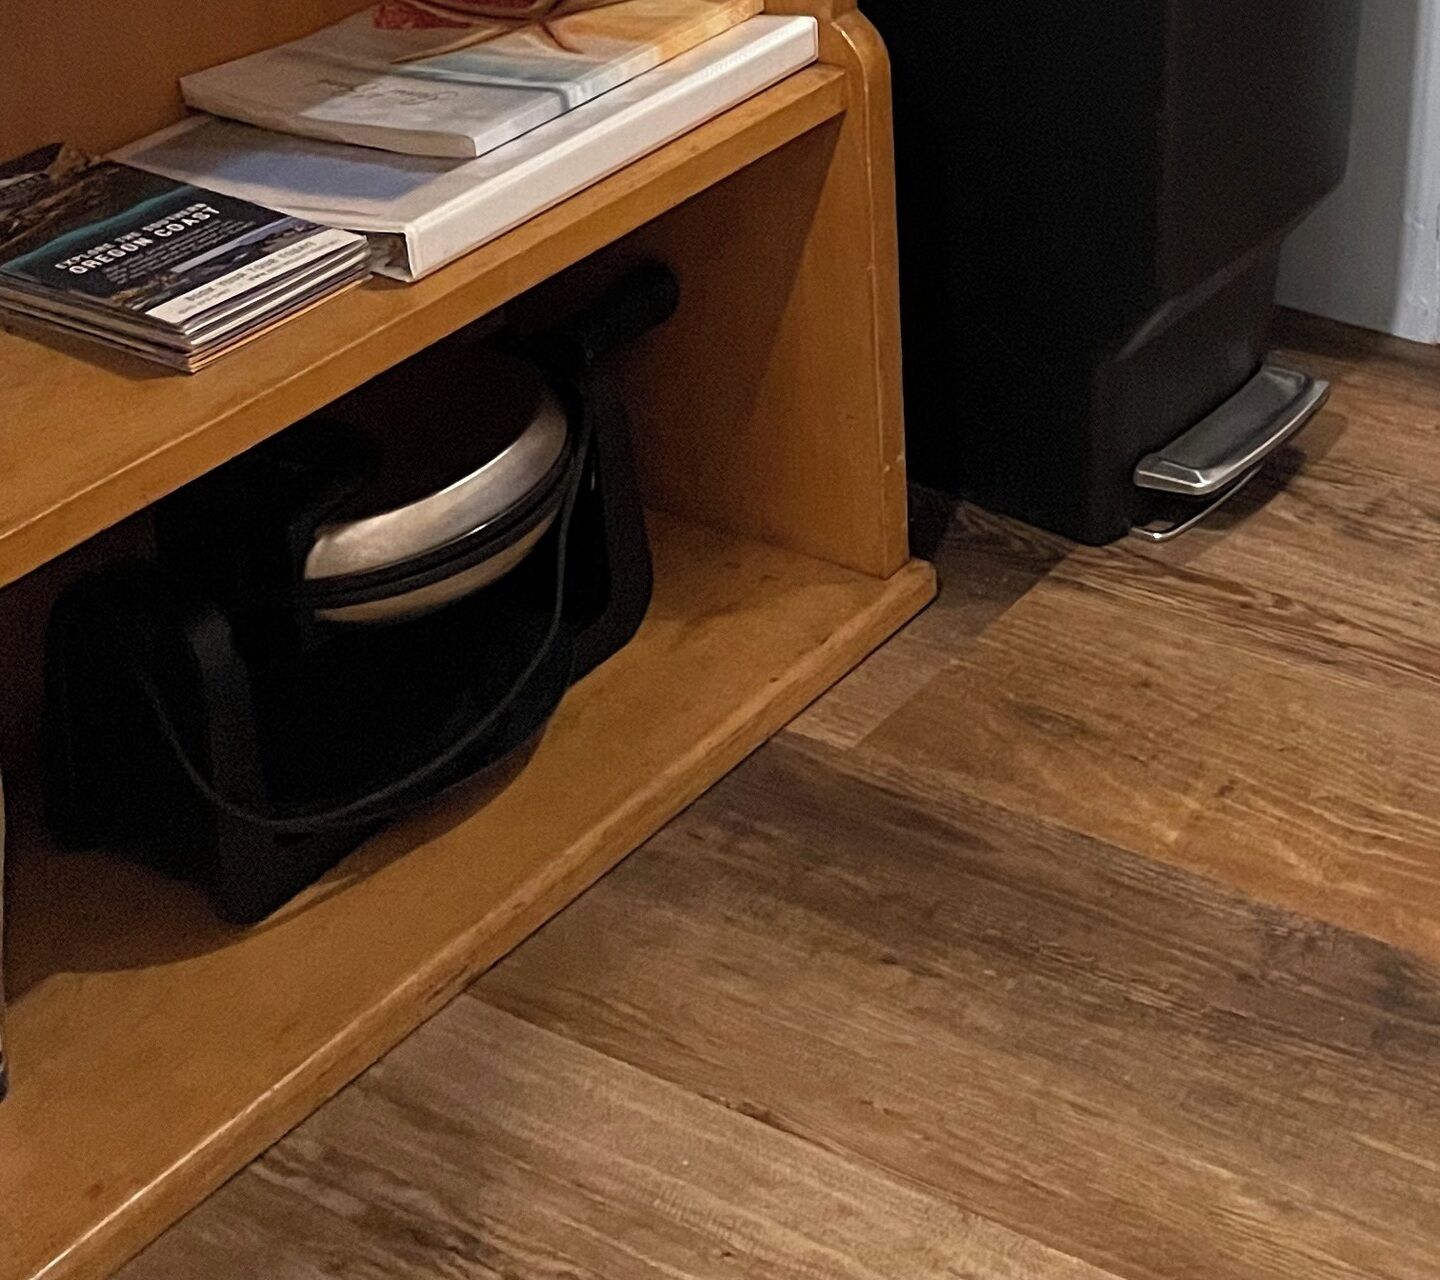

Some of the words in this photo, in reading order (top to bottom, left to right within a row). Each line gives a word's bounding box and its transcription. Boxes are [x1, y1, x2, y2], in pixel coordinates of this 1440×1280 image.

[55, 243, 116, 270] EXPLORE
[114, 231, 143, 244] THE
[69, 238, 153, 274] OREGON
[154, 206, 220, 237] COAST
